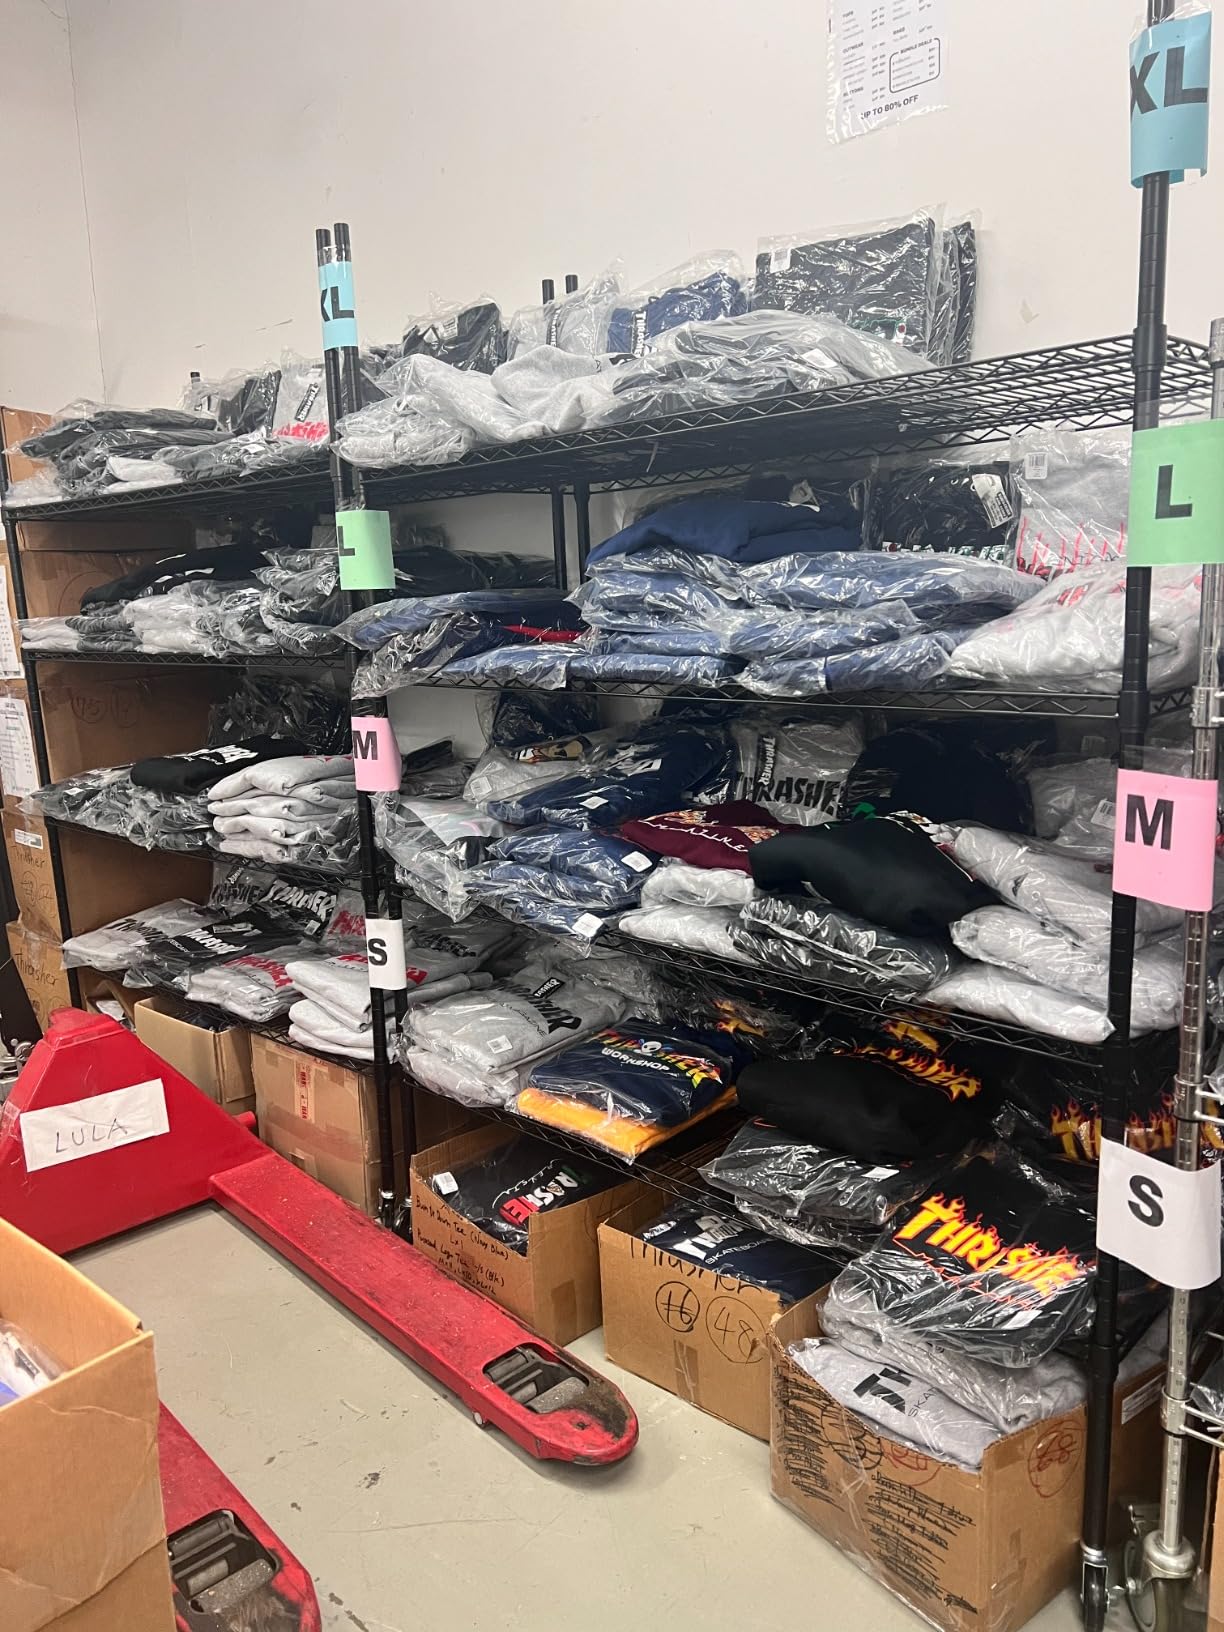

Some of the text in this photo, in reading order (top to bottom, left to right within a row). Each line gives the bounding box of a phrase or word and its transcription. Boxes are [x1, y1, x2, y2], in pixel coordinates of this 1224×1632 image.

[872, 106, 883, 116] TO
[884, 100, 902, 112] 80%
[903, 94, 919, 106] OFF
[1130, 46, 1208, 121] XL
[1155, 464, 1193, 520] L
[337, 526, 355, 556] L
[351, 730, 378, 760] M
[1124, 794, 1174, 850] M
[367, 938, 388, 966] S
[55, 1117, 129, 1154] LULA
[1128, 1175, 1164, 1227] S
[713, 1305, 754, 1366] 48
